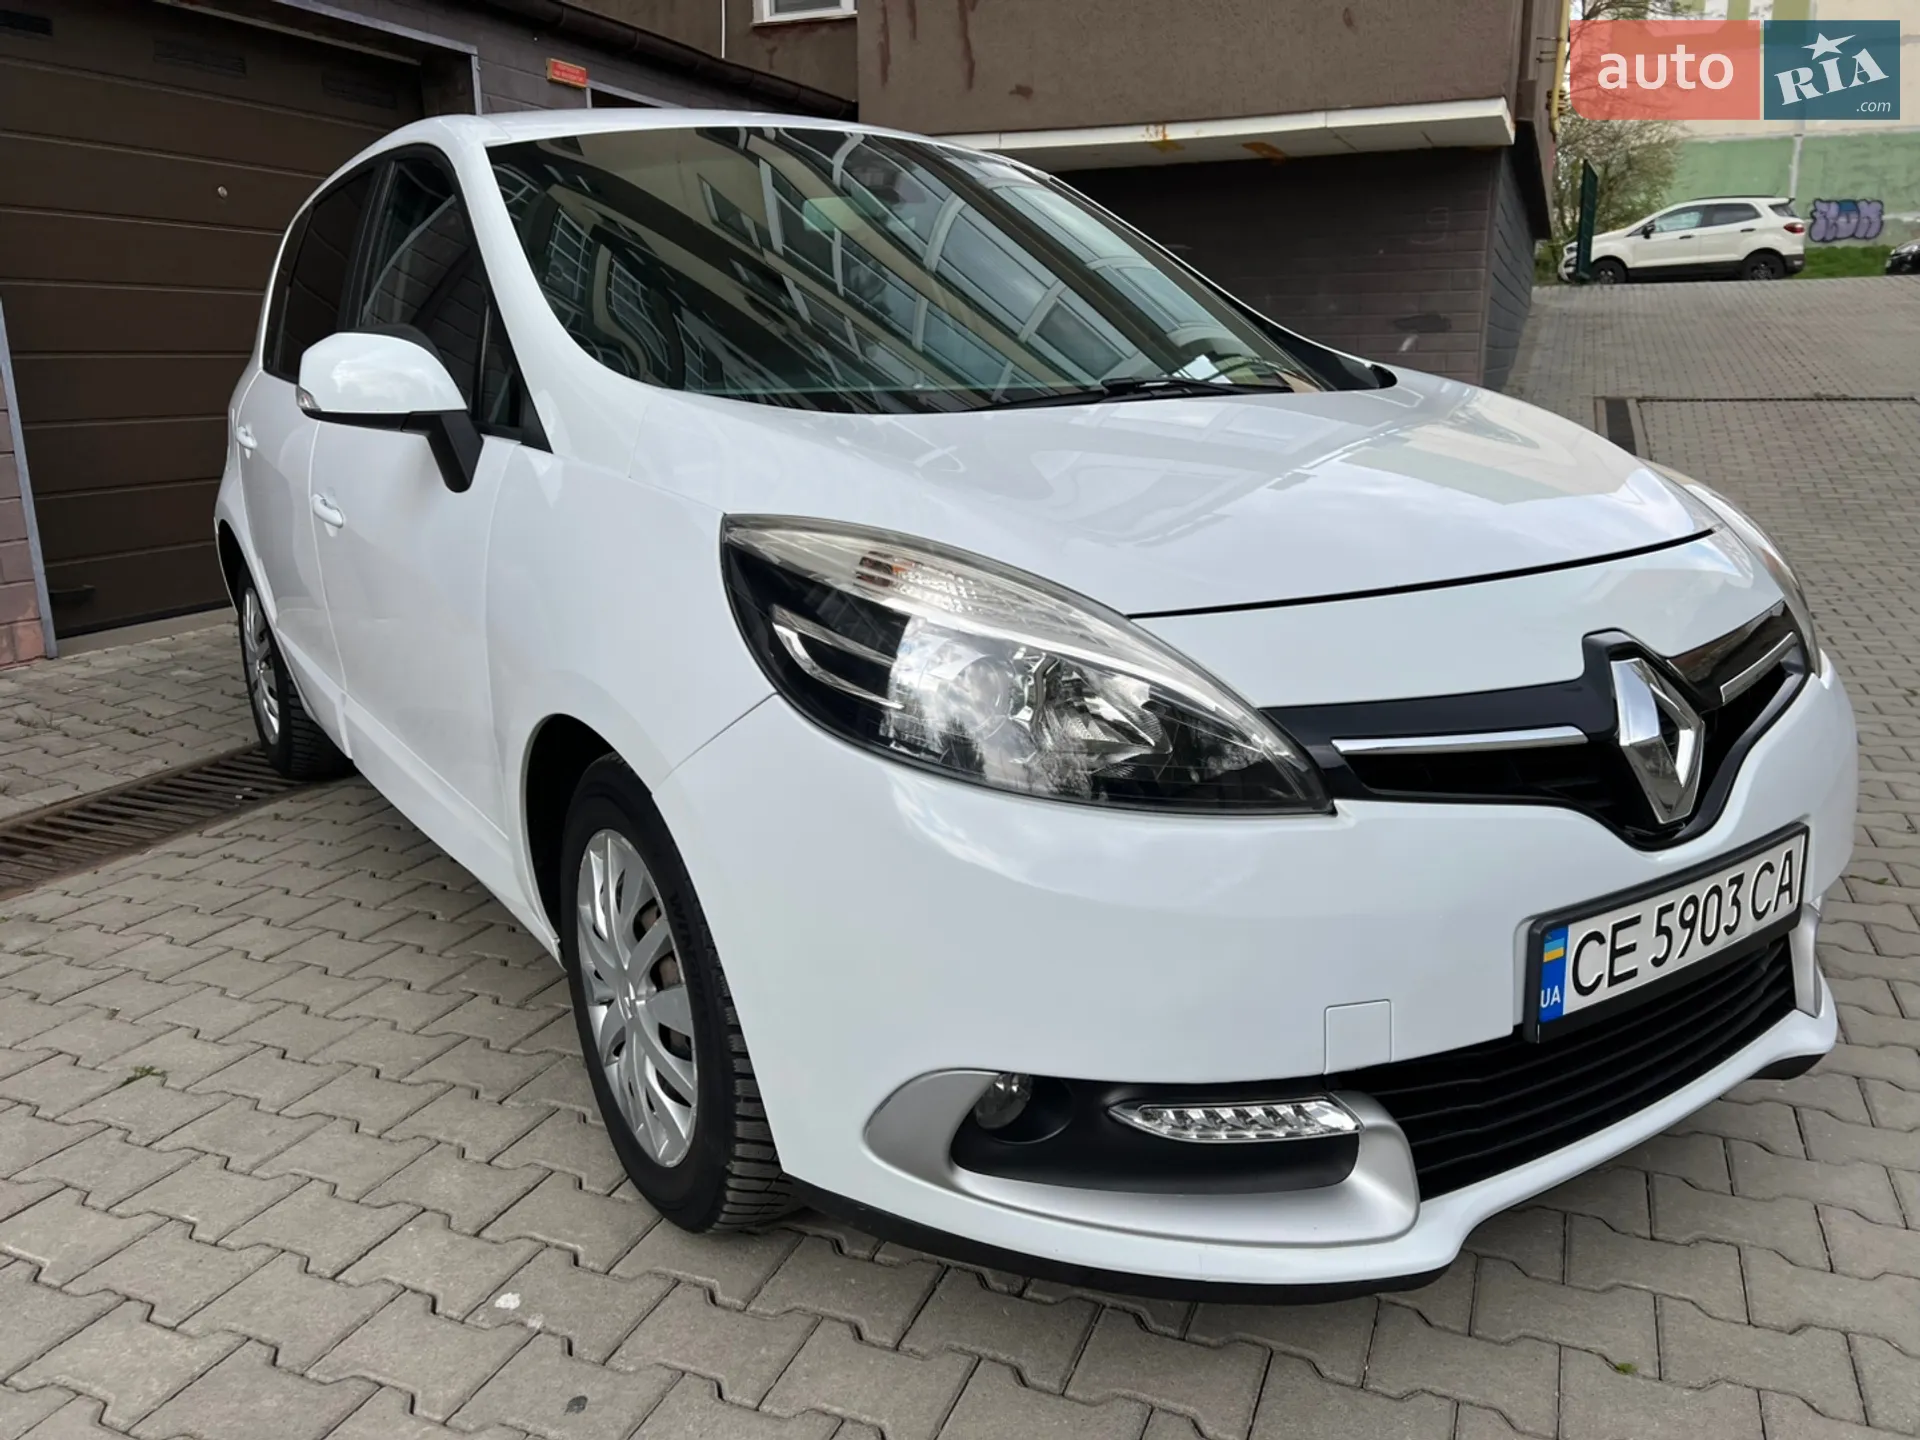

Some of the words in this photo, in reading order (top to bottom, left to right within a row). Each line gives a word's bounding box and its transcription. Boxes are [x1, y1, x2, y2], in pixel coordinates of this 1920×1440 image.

[1572, 914, 1642, 997] CE
[1649, 872, 1745, 968] 5903
[1751, 849, 1793, 921] CA
[1540, 985, 1561, 1008] UA
